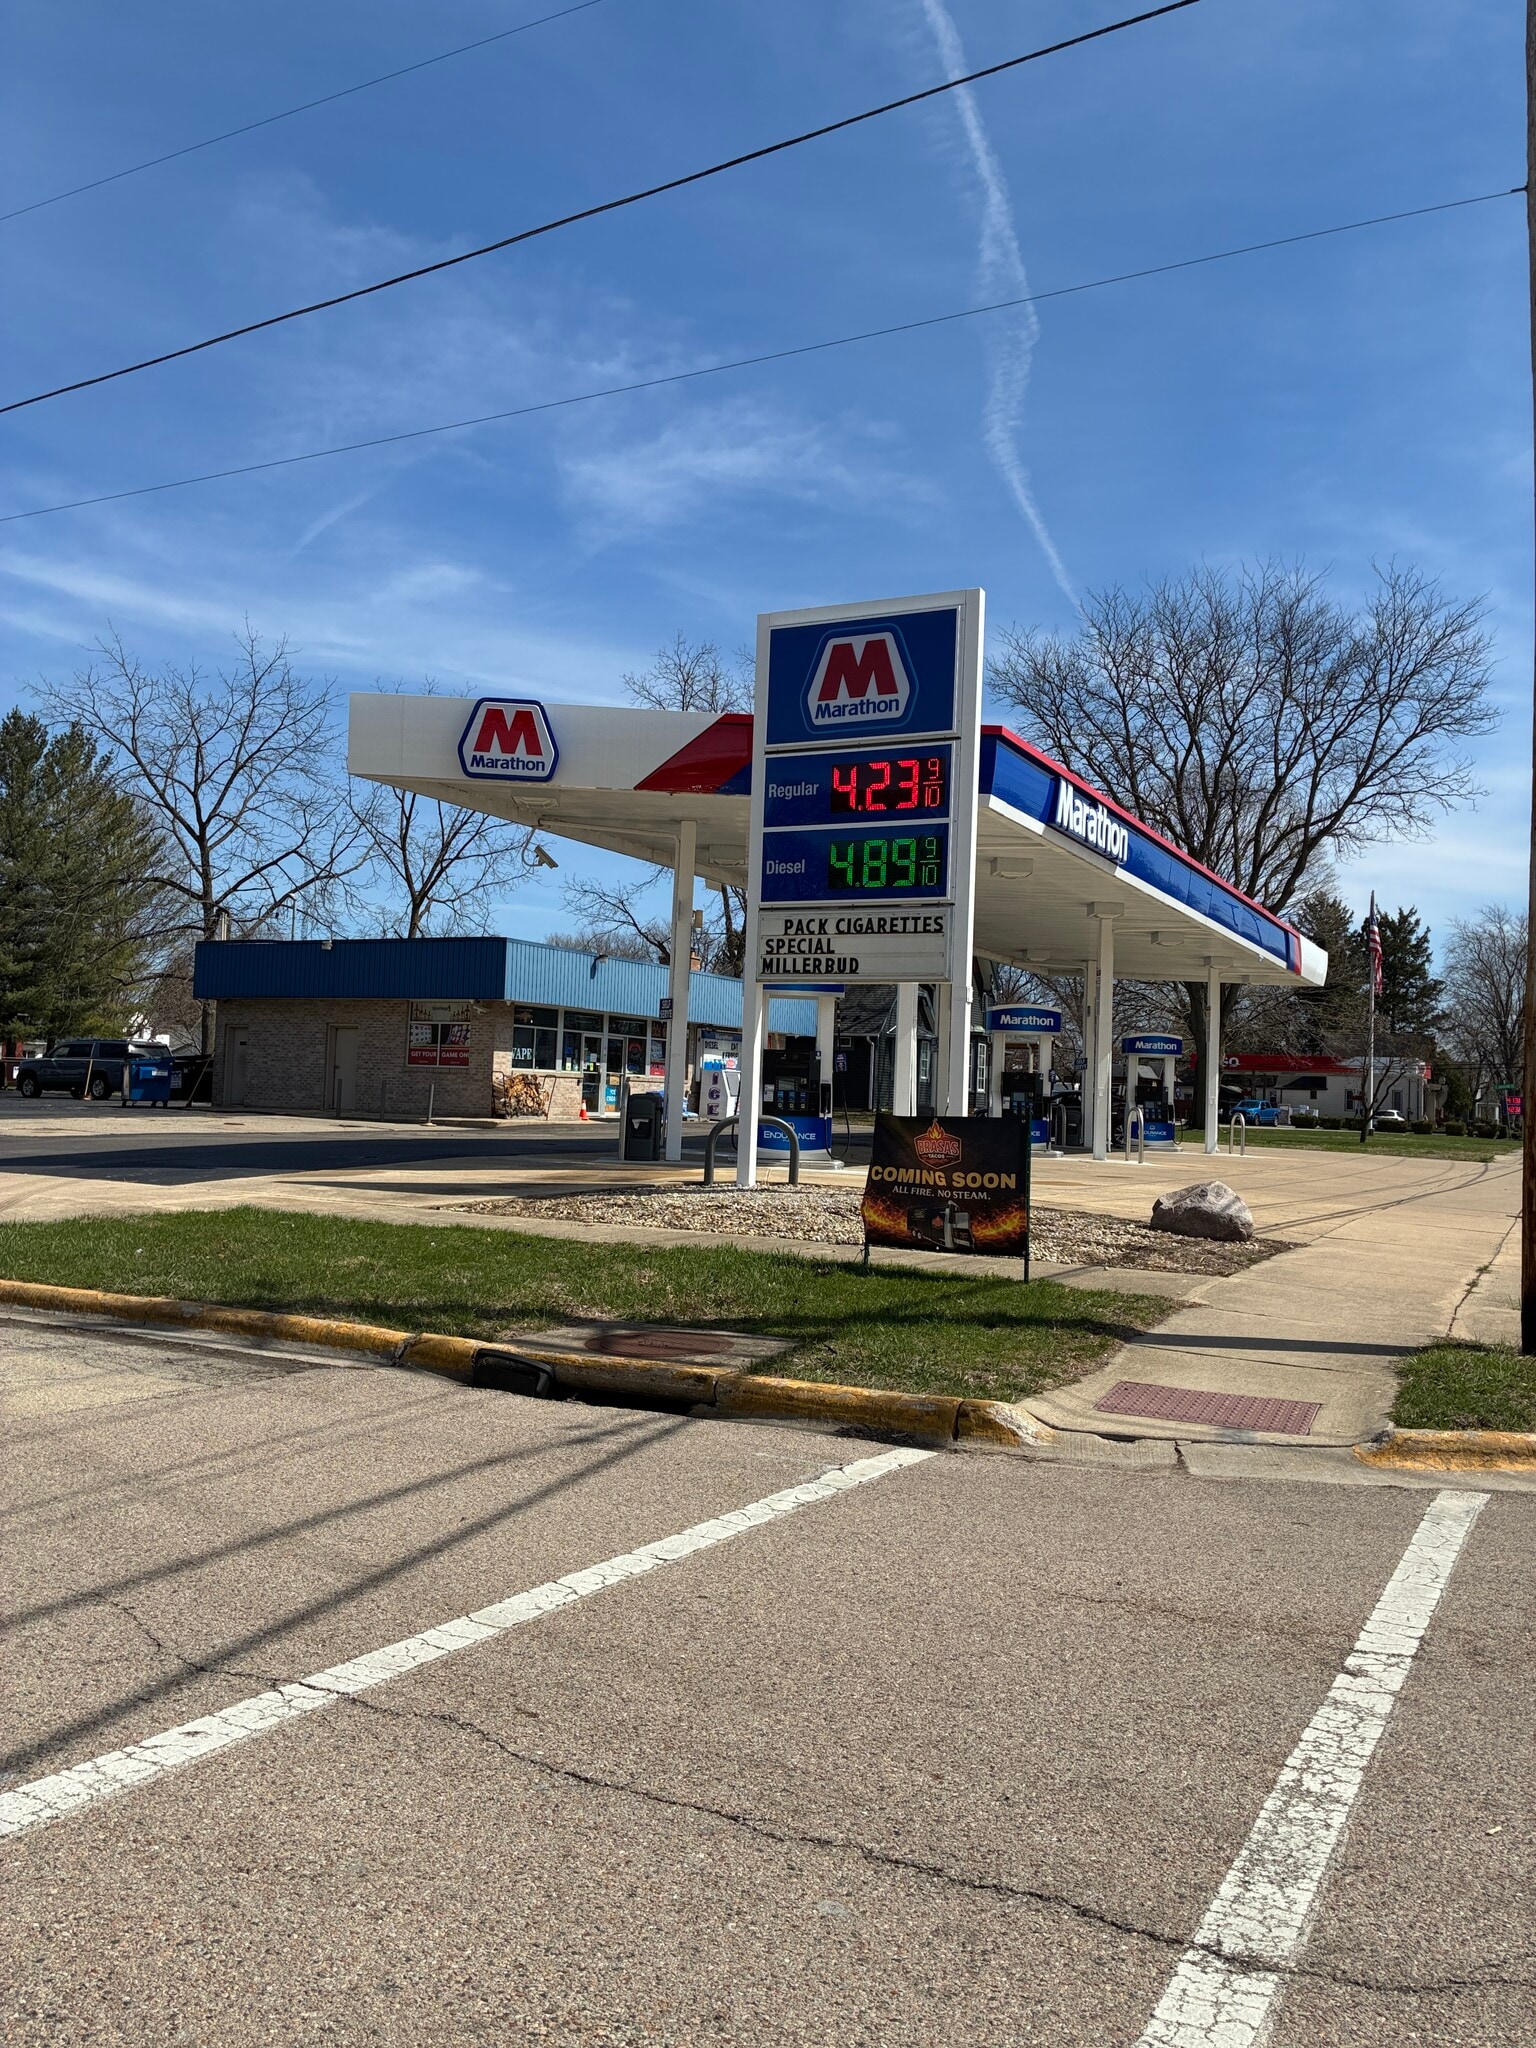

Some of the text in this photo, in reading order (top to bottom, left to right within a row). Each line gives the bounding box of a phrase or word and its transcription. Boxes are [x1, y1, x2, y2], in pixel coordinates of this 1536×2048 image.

[815, 699, 899, 719] Marathon
[470, 754, 546, 772] Marathon
[768, 782, 819, 800] Regular
[833, 760, 919, 811] 4.23
[1056, 778, 1128, 863] Marathon
[766, 859, 805, 875] Diesel
[831, 838, 917, 887] 4.89
[784, 916, 944, 936] PACK CIGARETTES
[765, 938, 835, 955] SPECIAL
[1000, 1014, 1054, 1027] Marathon
[512, 1047, 532, 1060] VAPE
[1135, 1040, 1177, 1051] Marathon
[764, 1130, 816, 1140] ENDUNCE
[916, 1140, 960, 1157] BRASAS
[871, 1165, 1016, 1189] COMING SOON
[892, 1185, 991, 1200] ALL FIRE. NO STEAM.
